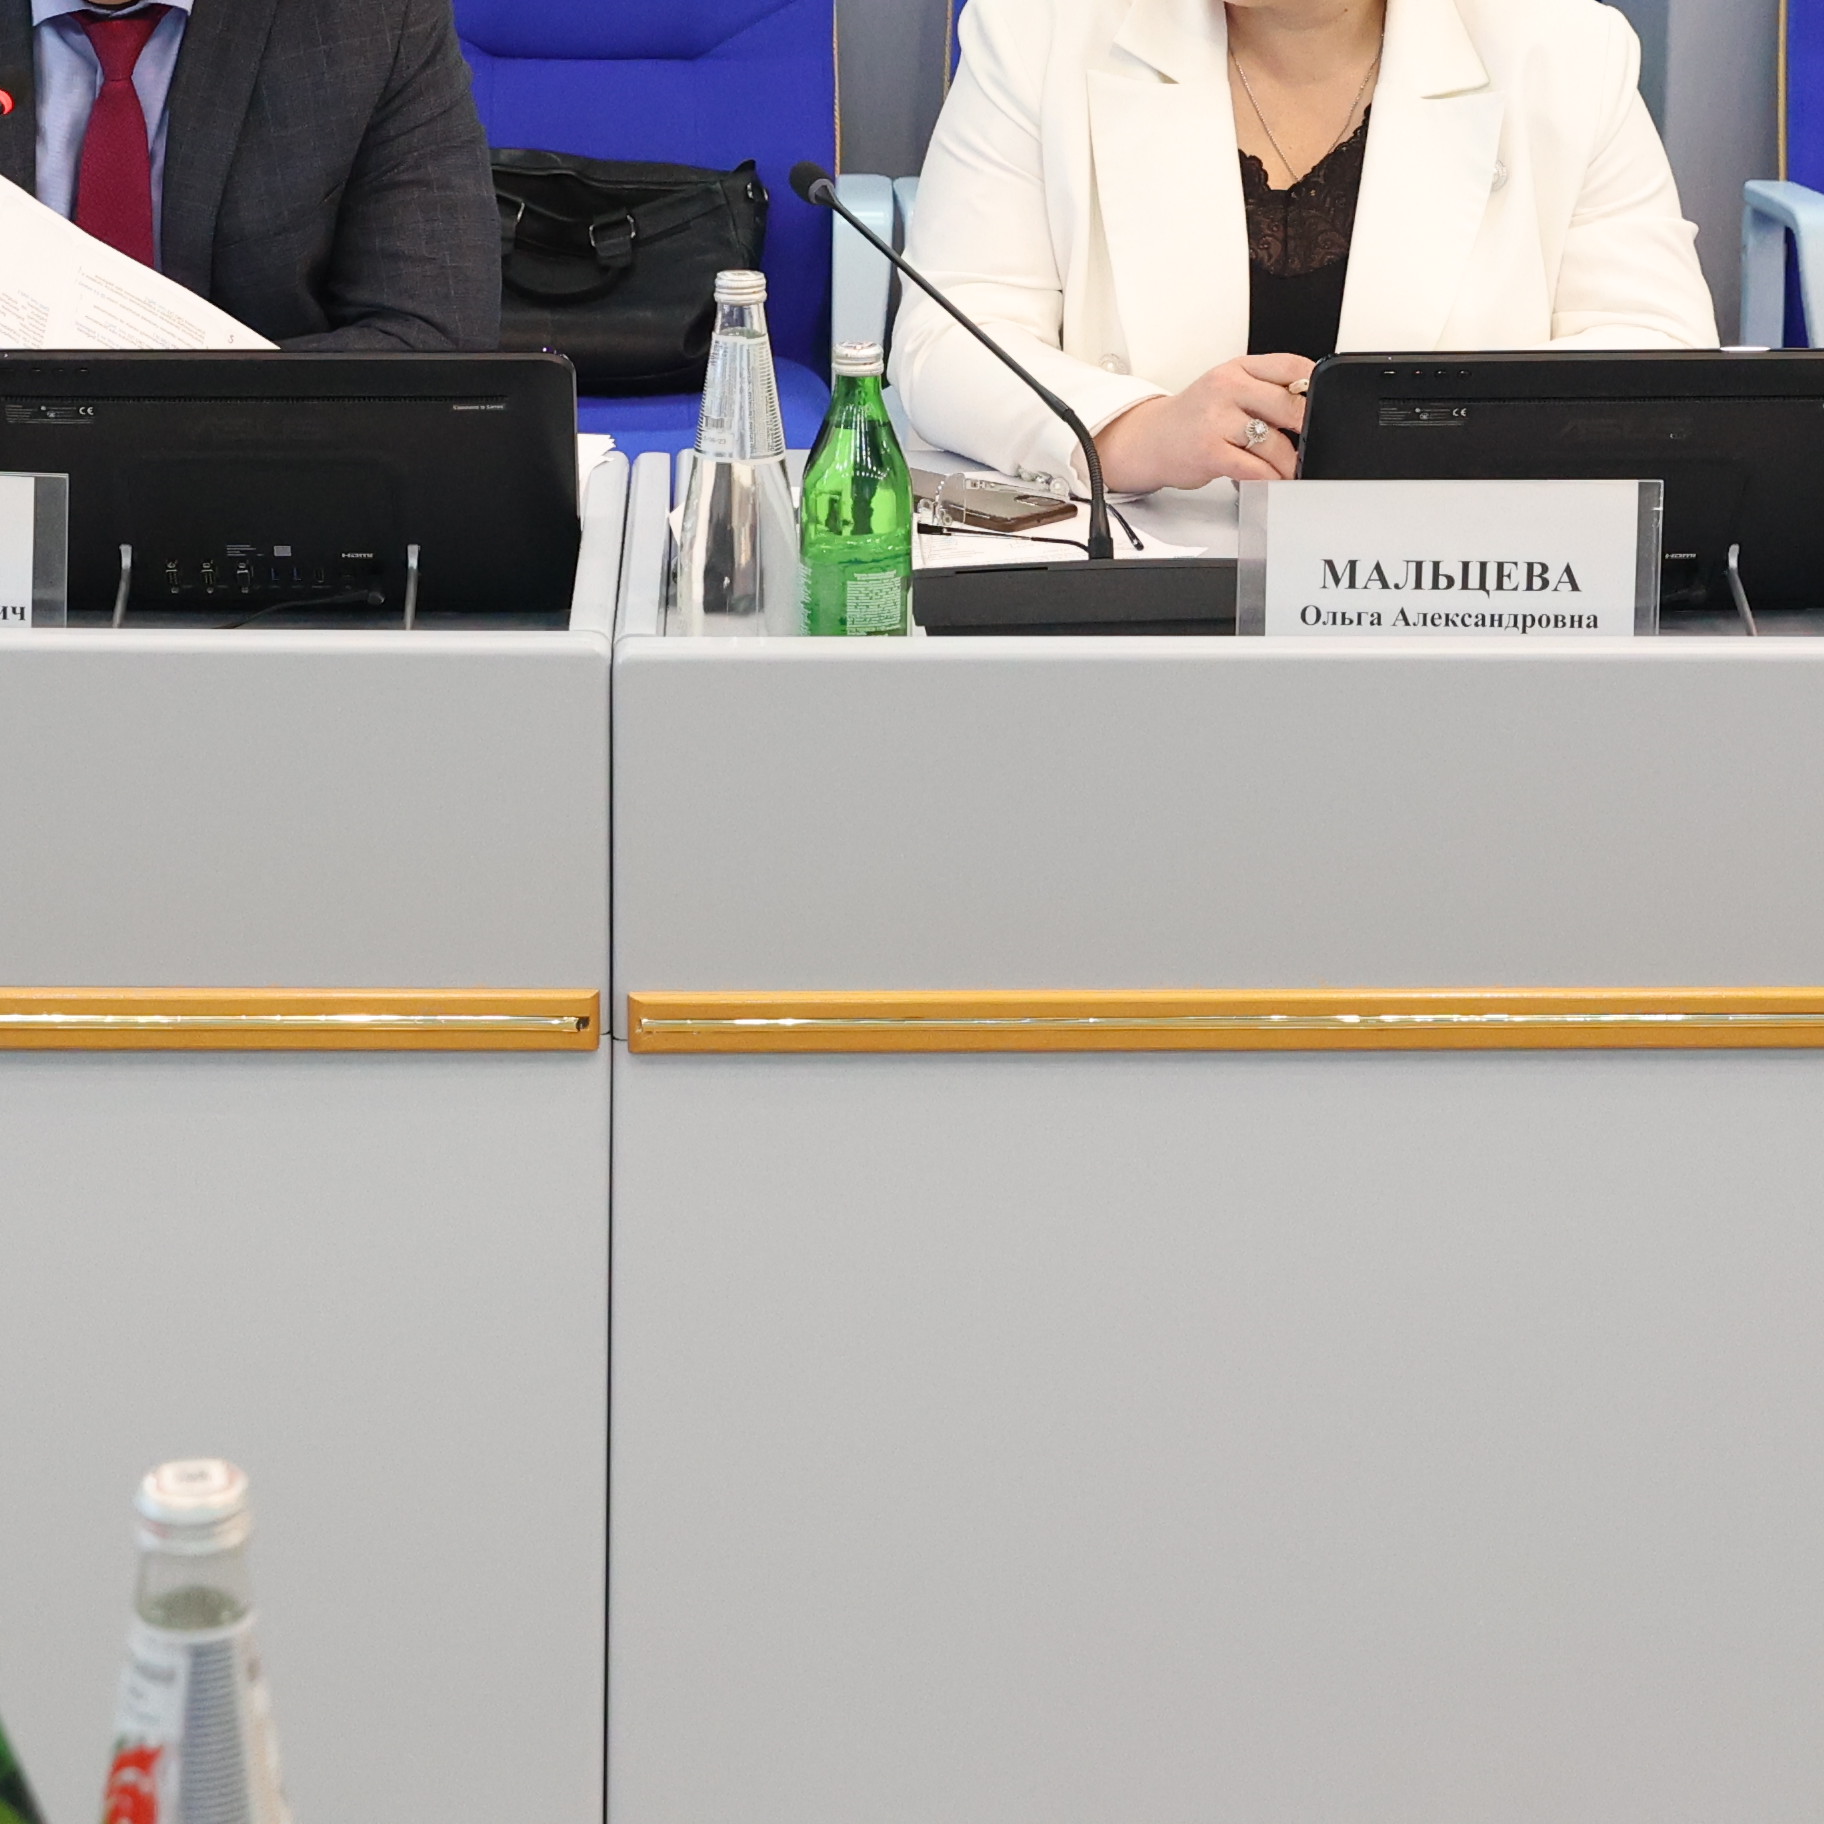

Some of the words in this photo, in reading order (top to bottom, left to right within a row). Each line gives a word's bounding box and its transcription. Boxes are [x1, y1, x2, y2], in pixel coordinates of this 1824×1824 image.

[1320, 558, 1582, 599] МАЛЬЦЕВА
[1300, 604, 1383, 626] Ольга
[1391, 606, 1600, 635] Александровна
